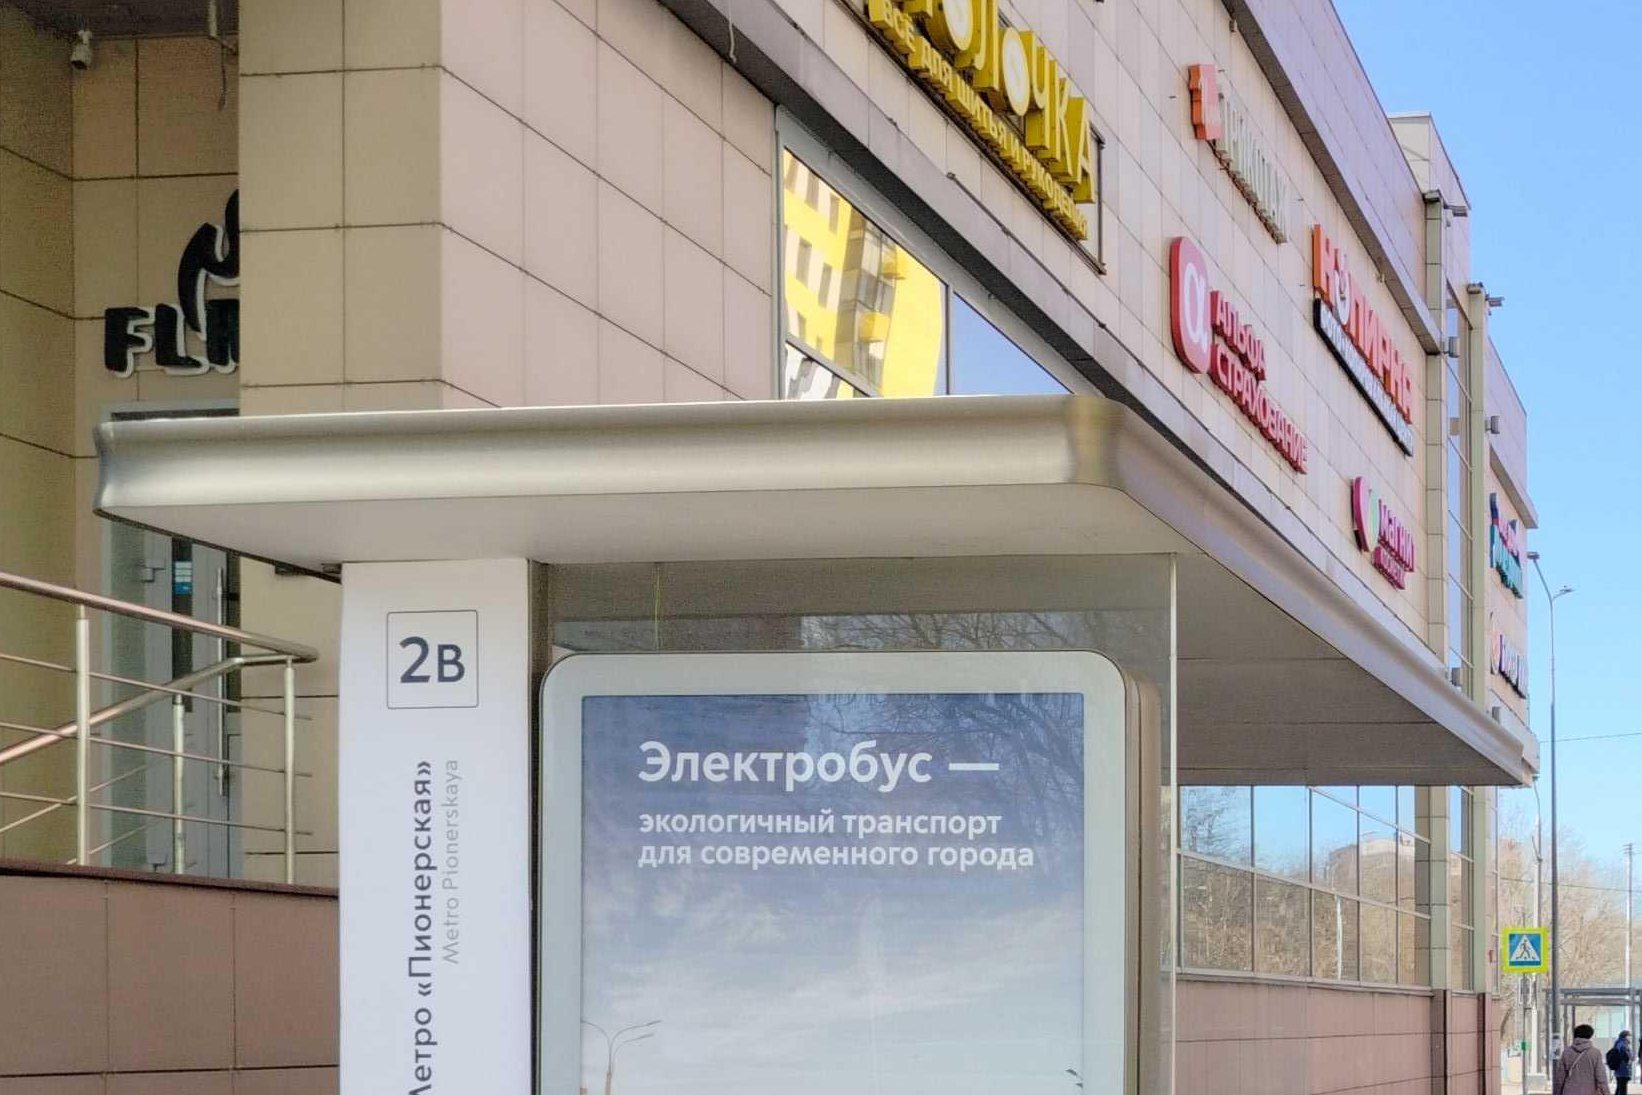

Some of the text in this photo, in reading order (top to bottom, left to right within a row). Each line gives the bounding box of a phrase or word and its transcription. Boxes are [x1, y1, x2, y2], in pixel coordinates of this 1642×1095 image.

[1210, 290, 1266, 381] АЛЬФА
[1209, 342, 1308, 475] СТРАХОВАНИЕ
[637, 740, 933, 794] Электробус
[442, 759, 461, 965] Metro Pionerskaya
[637, 844, 1035, 872] для современного города
[638, 807, 1002, 840] экологичный транспорт
[408, 760, 438, 998] «Пионерская»
